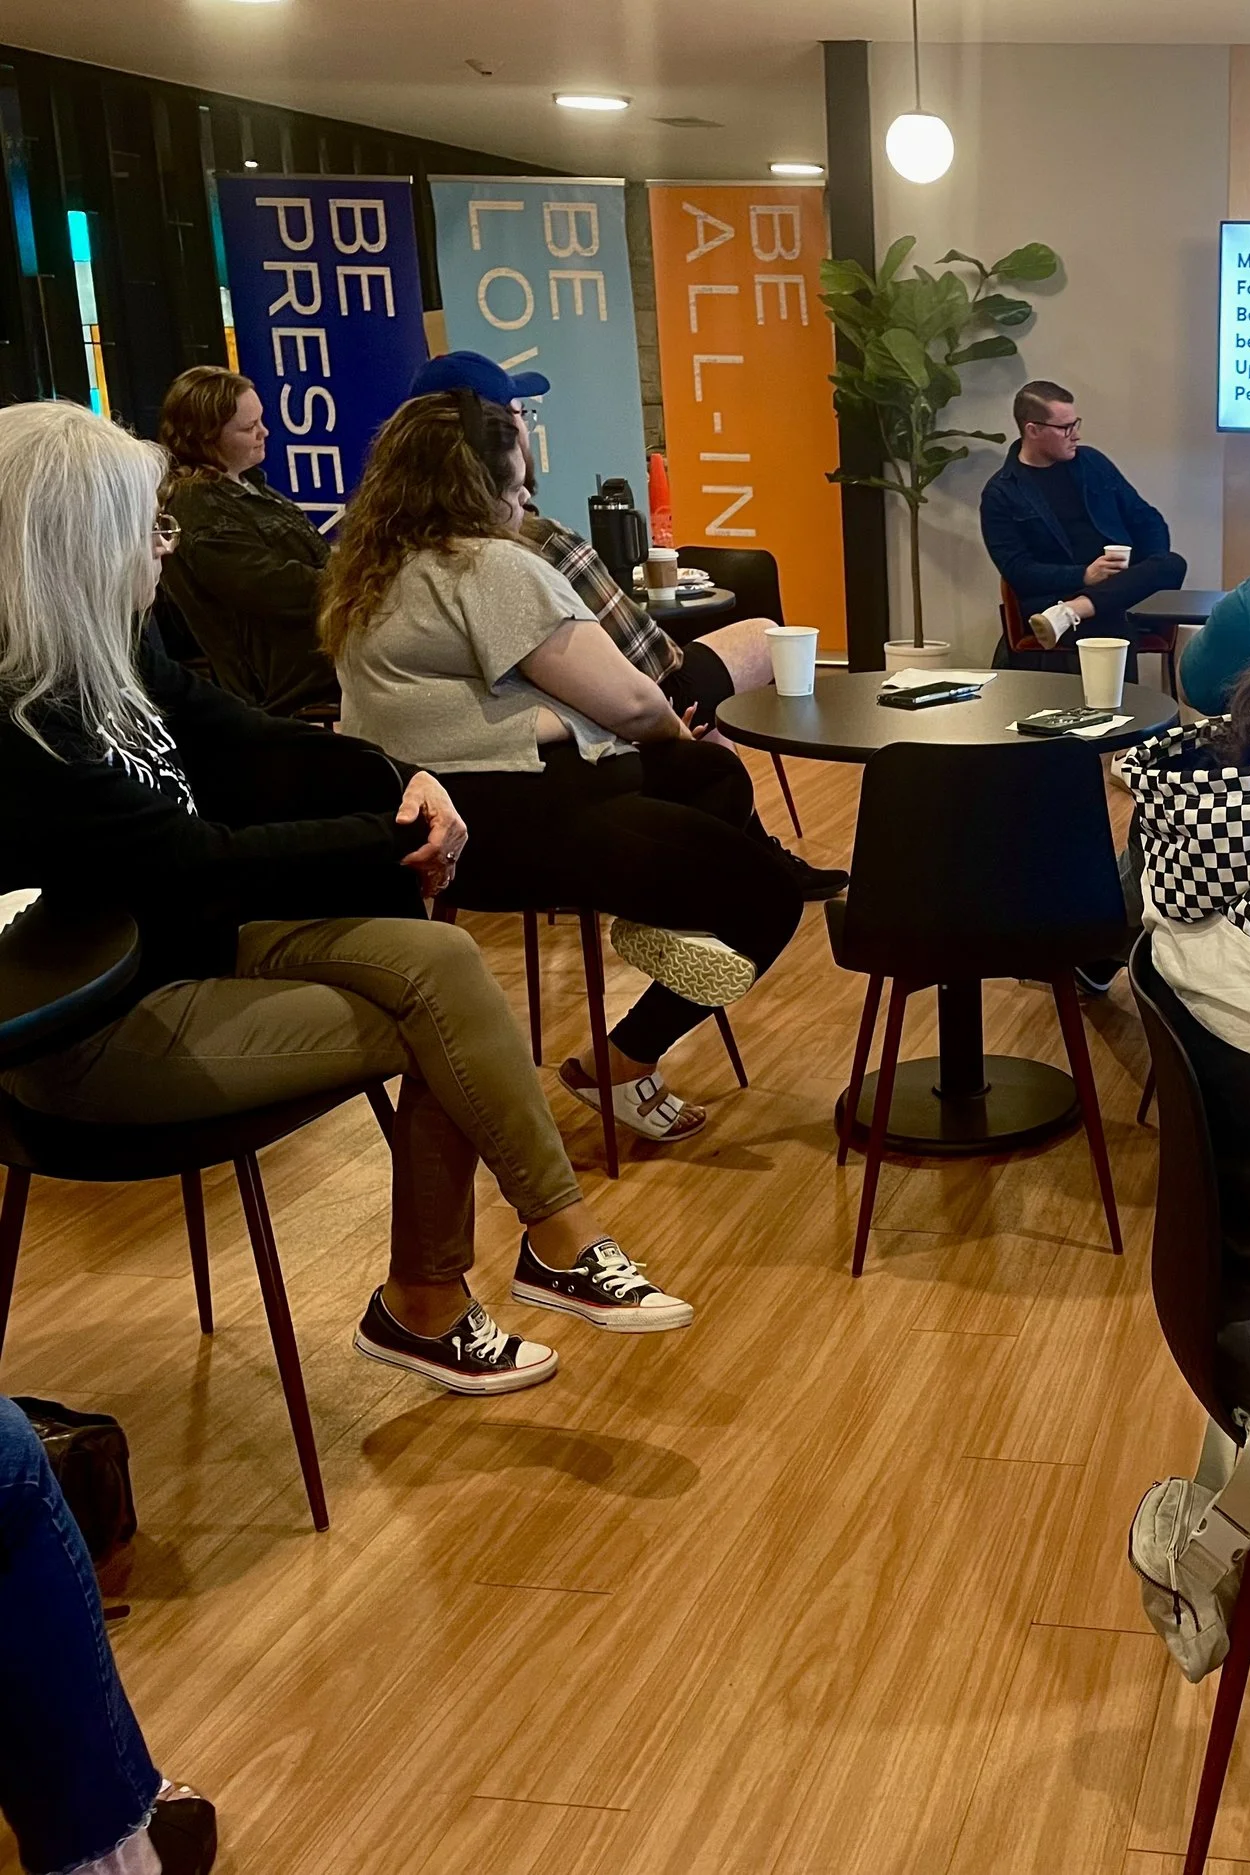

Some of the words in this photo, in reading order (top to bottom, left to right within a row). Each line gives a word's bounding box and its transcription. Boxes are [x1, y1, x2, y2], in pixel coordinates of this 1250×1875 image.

[328, 198, 396, 318] BE
[543, 201, 608, 322] BE
[750, 204, 809, 326] BE
[682, 201, 756, 537] ALL-IN
